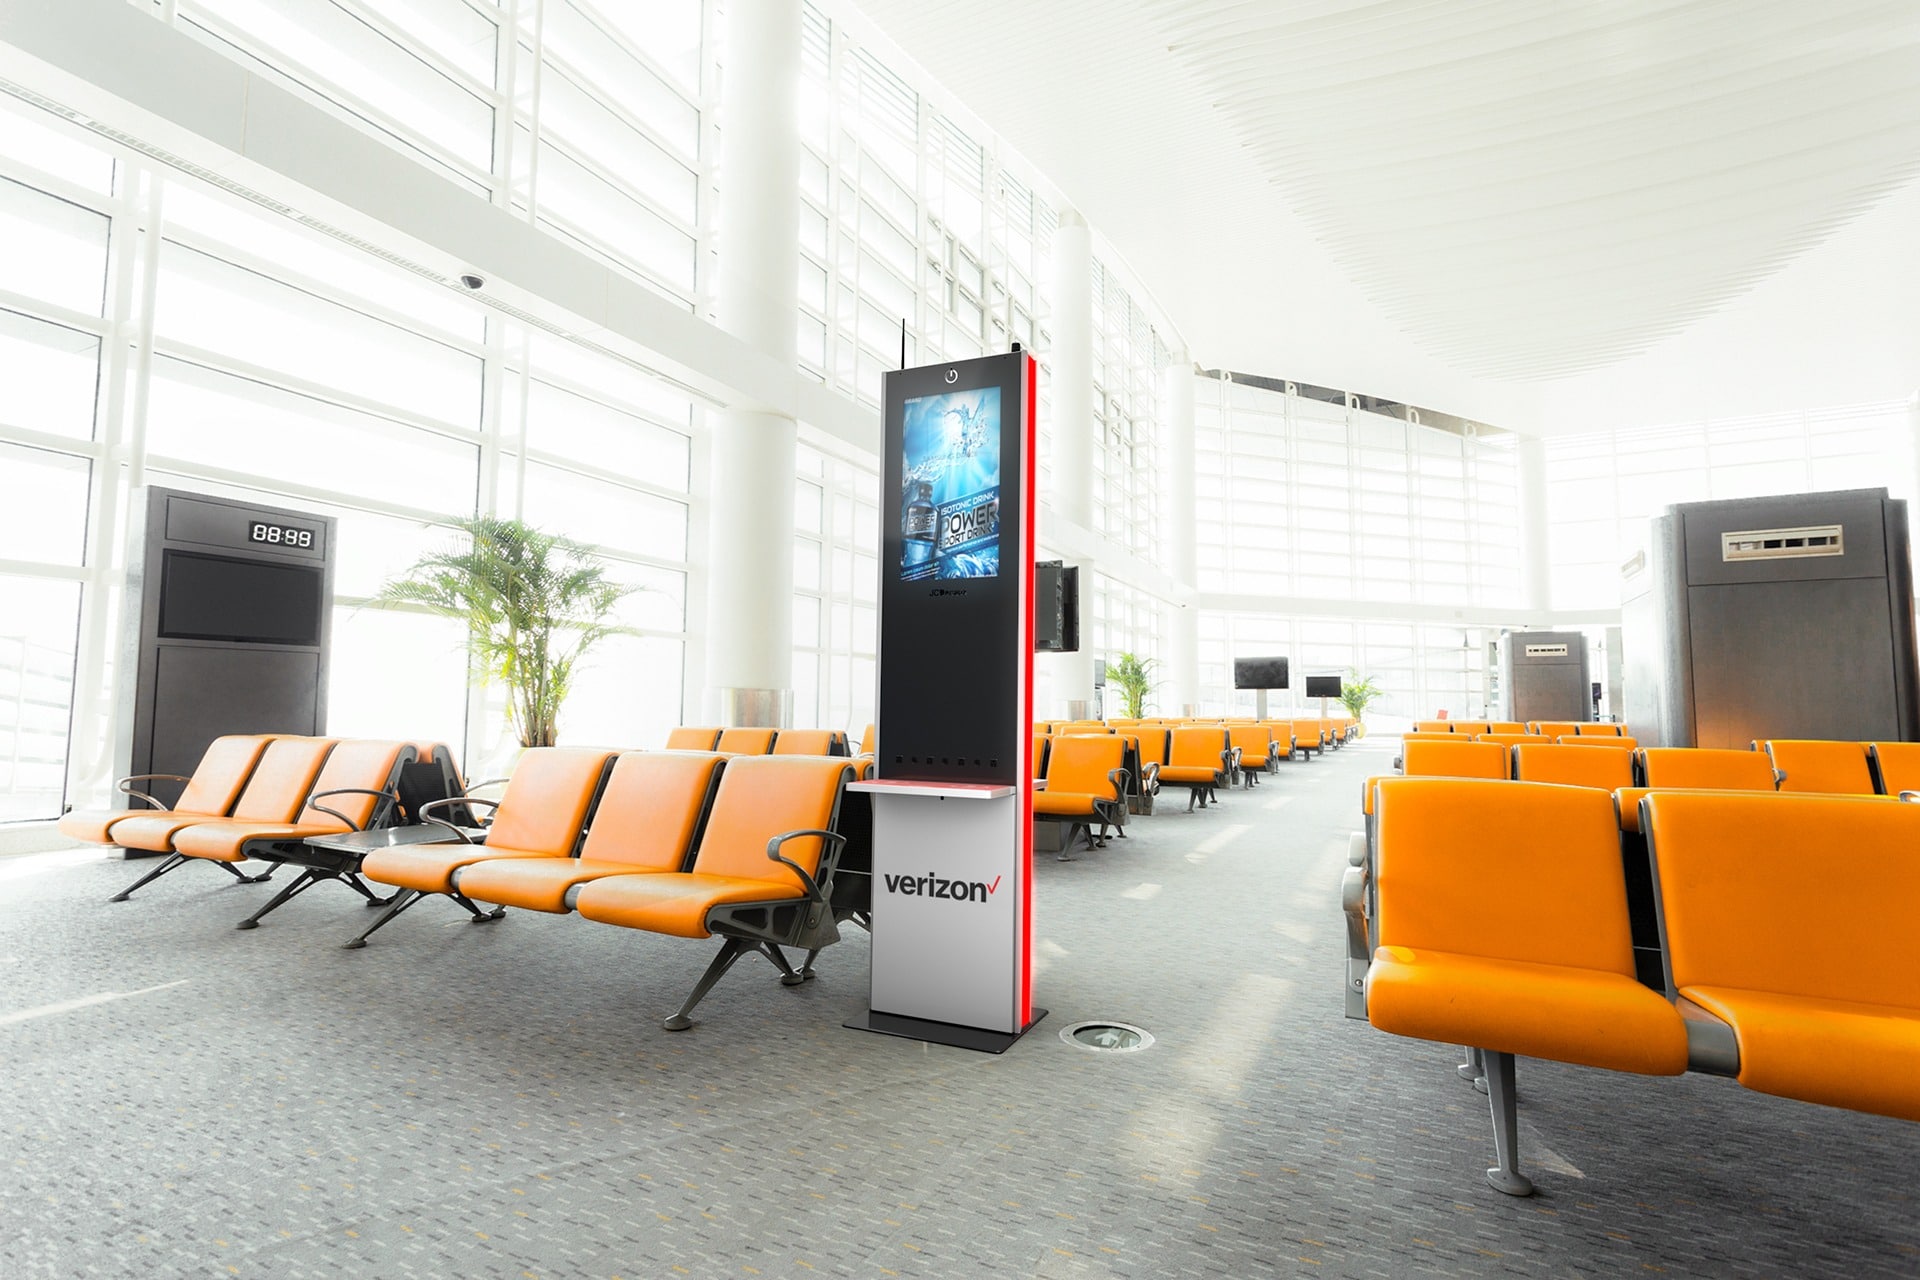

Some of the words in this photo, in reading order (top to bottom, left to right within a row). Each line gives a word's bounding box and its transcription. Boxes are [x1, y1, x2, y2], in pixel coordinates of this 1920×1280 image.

[941, 499, 972, 515] ISOTONIC
[972, 491, 994, 505] DRINK
[942, 501, 998, 534] POWER
[884, 872, 987, 903] verizon
